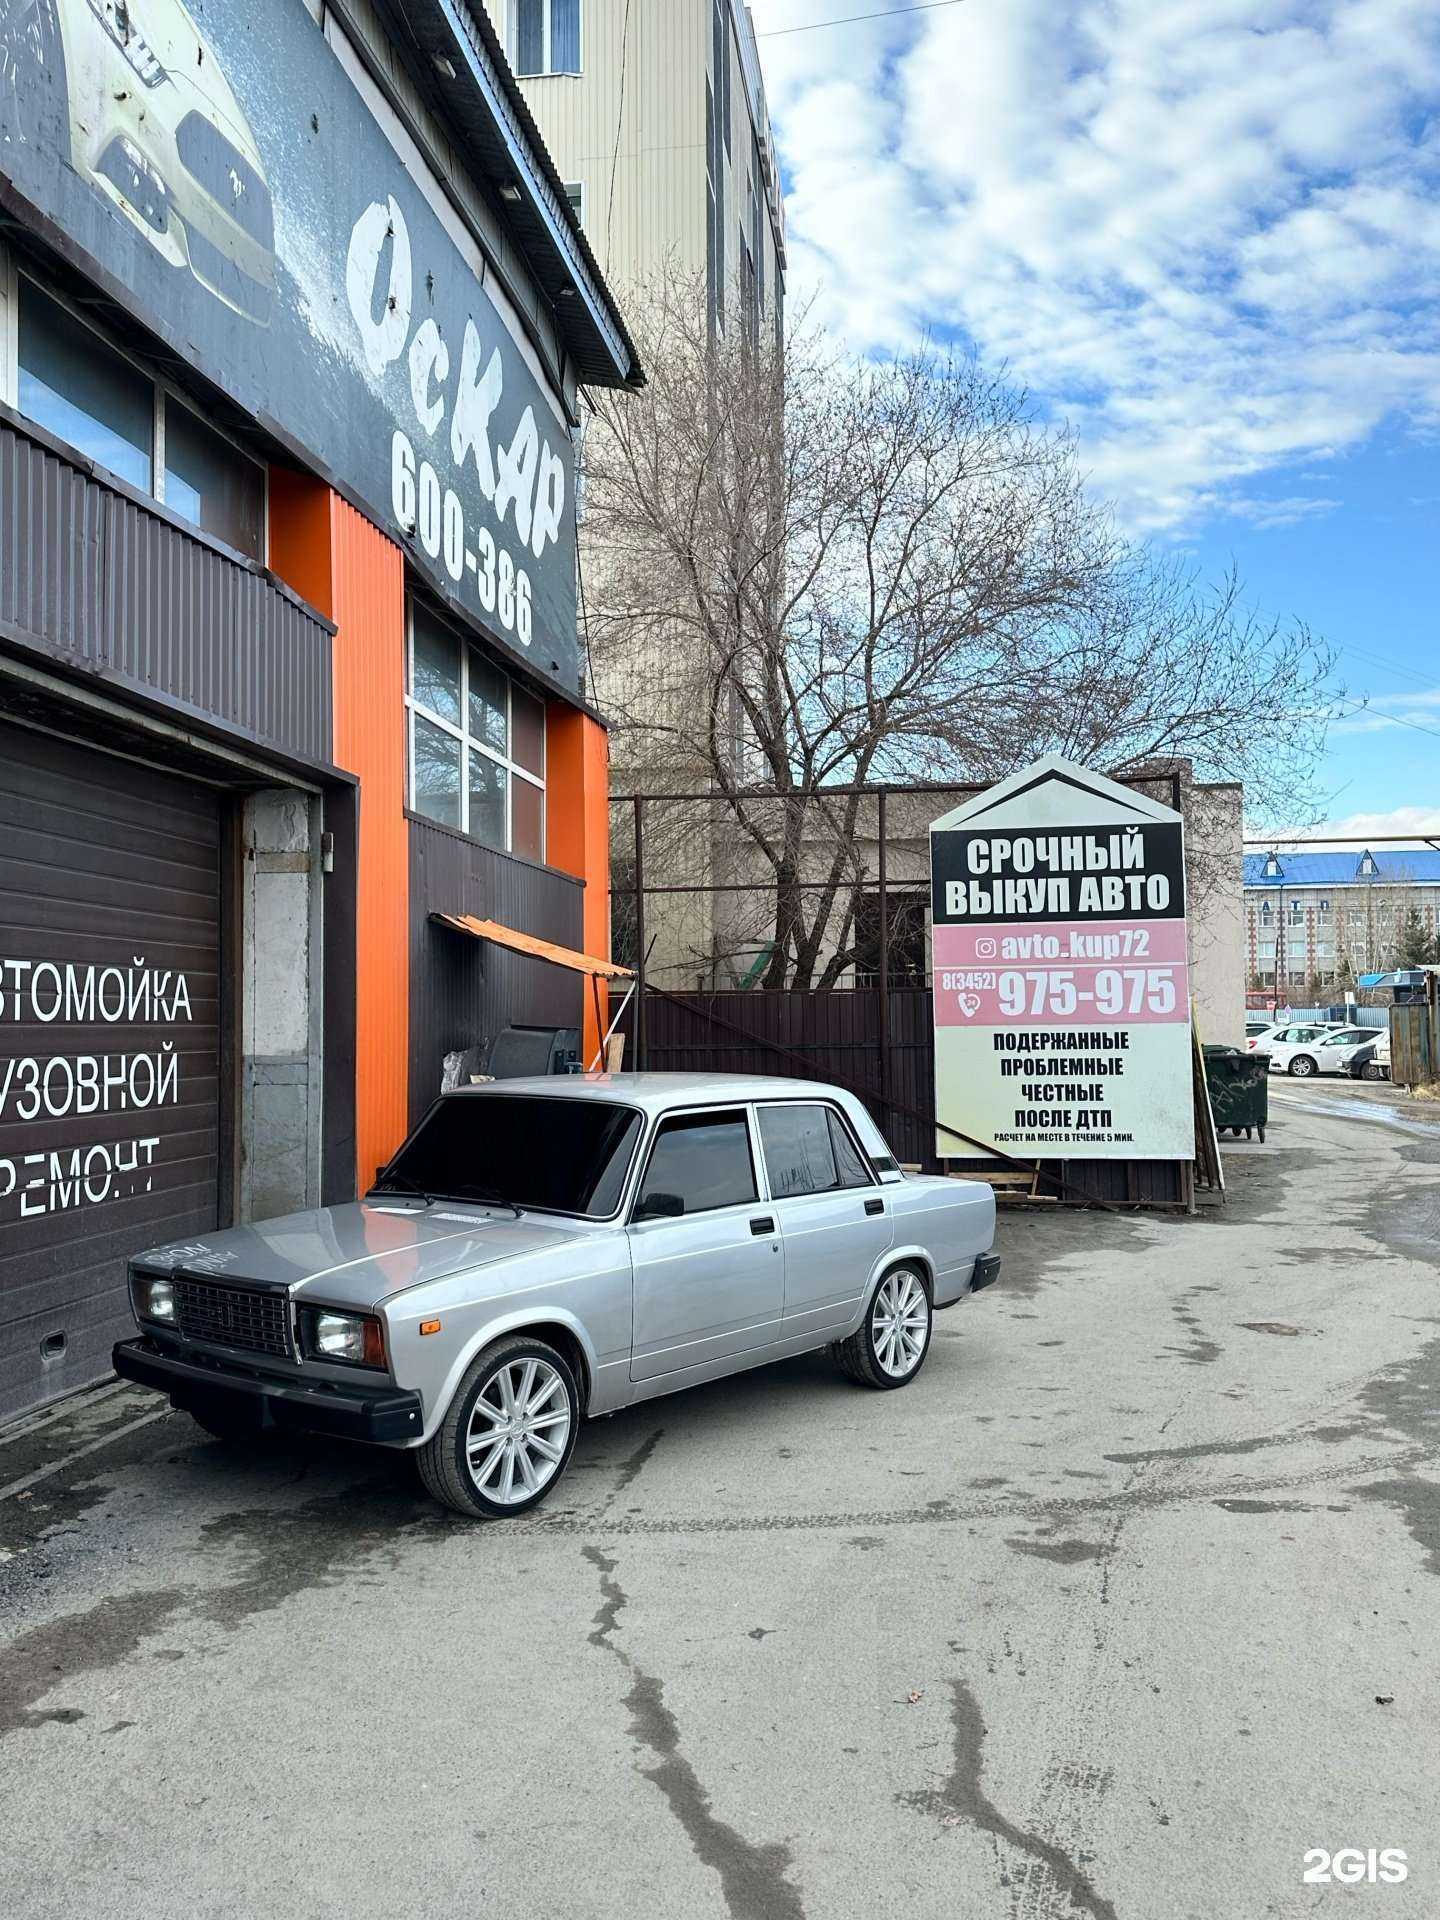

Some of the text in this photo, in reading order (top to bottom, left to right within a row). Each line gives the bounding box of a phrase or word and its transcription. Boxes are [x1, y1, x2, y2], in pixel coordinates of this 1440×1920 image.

[391, 430, 533, 646] 600-386
[967, 827, 1144, 874] СРОЧНЫЙ
[945, 874, 1170, 915] ВЫКУП АВТО
[1001, 929, 1150, 960] avto_kup72
[942, 969, 1176, 1016] 8(3452) 975-975
[993, 1032, 1129, 1052] ПОДЕРЖАННЫЕ
[1001, 1058, 1123, 1076] ПРОБЛЕМНЫЕ
[1021, 1084, 1103, 1102] ЧЕСТНЫЕ
[1015, 1110, 1112, 1130] ПОСЛЕ ДТП
[994, 1132, 1135, 1142] РАСЧЕТ НА МЕСТЕ В ТЕЧЕНИЕ 5 МИН.
